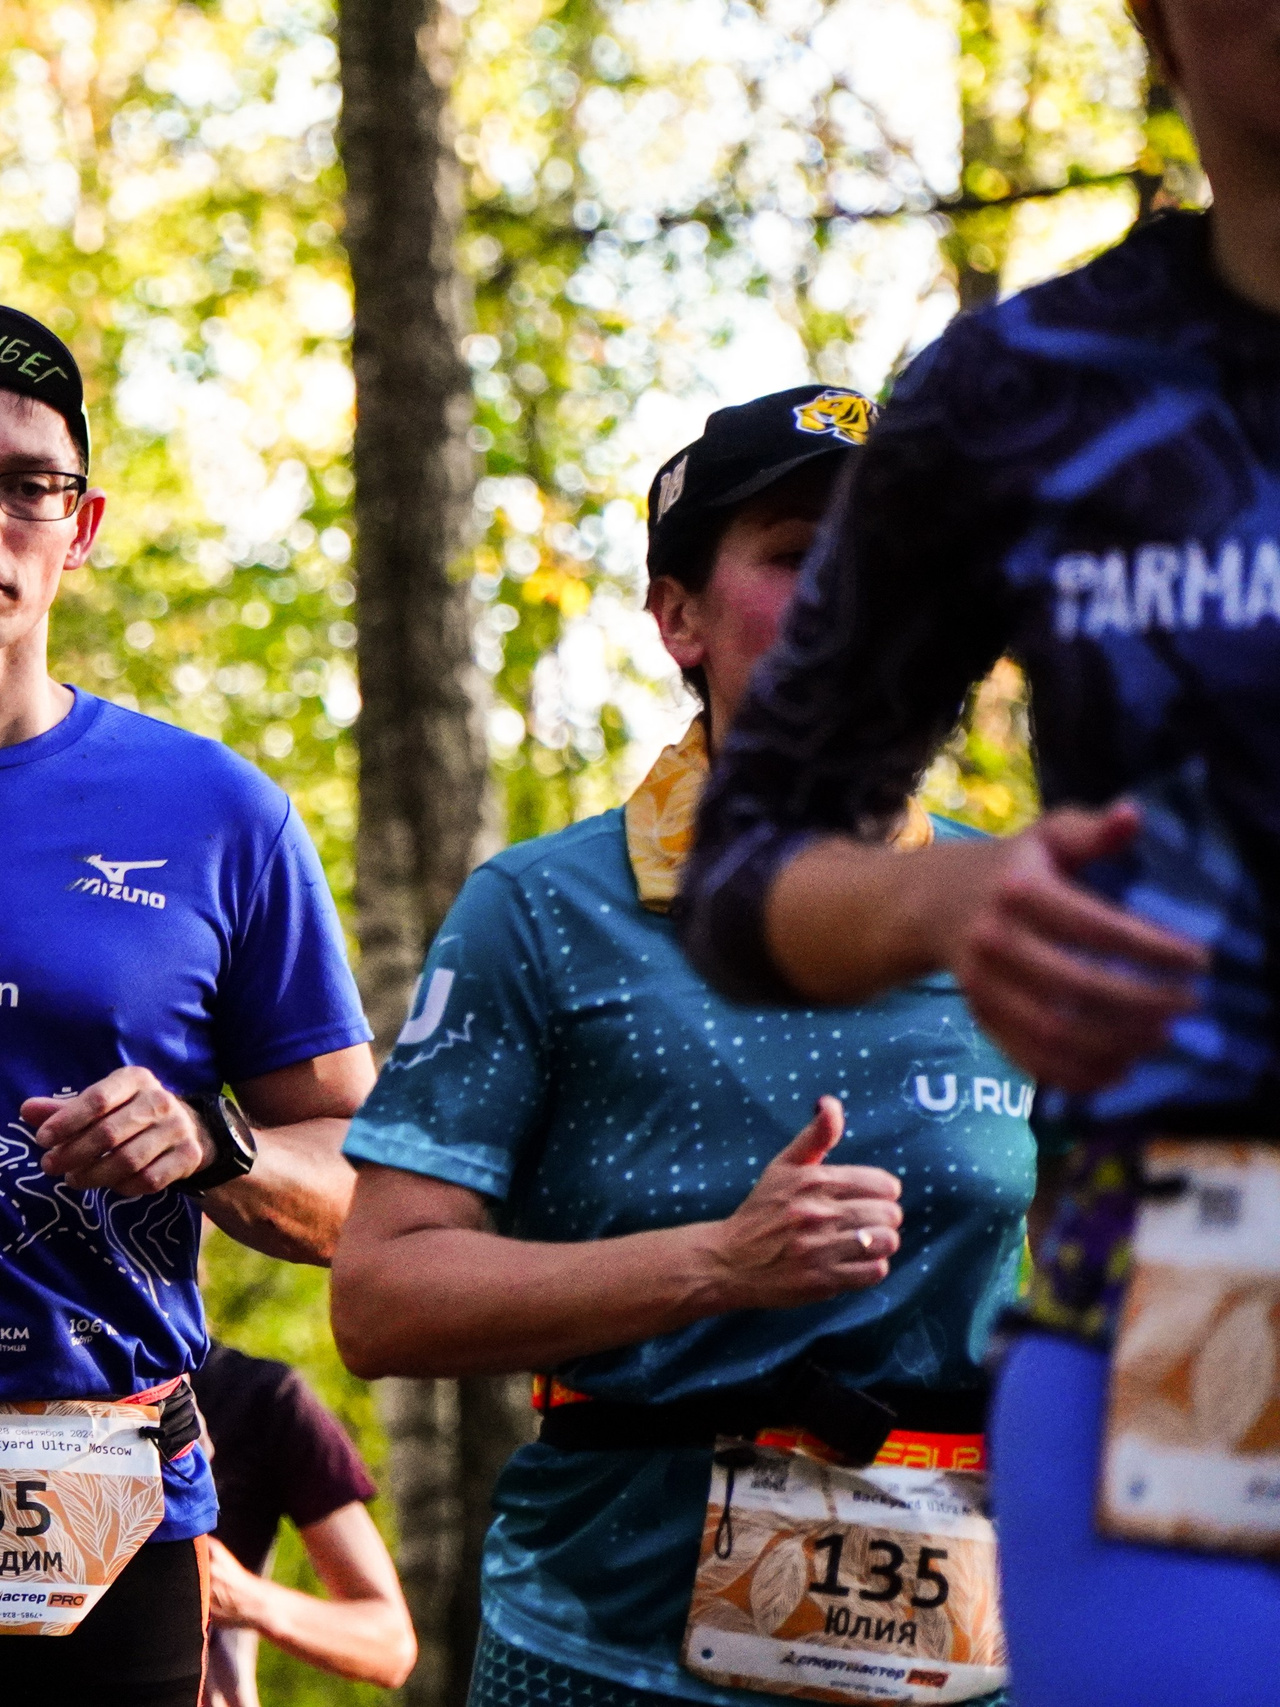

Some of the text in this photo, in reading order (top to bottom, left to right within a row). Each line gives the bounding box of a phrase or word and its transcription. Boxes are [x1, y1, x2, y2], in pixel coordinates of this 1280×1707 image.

[69, 1318, 102, 1333] 106
[70, 1430, 94, 1438] 2024
[42, 1440, 81, 1452] Ultra
[88, 1443, 132, 1456] Moscow
[809, 1534, 949, 1609] 135
[51, 1595, 85, 1606] PRO
[824, 1605, 918, 1645] Юлия
